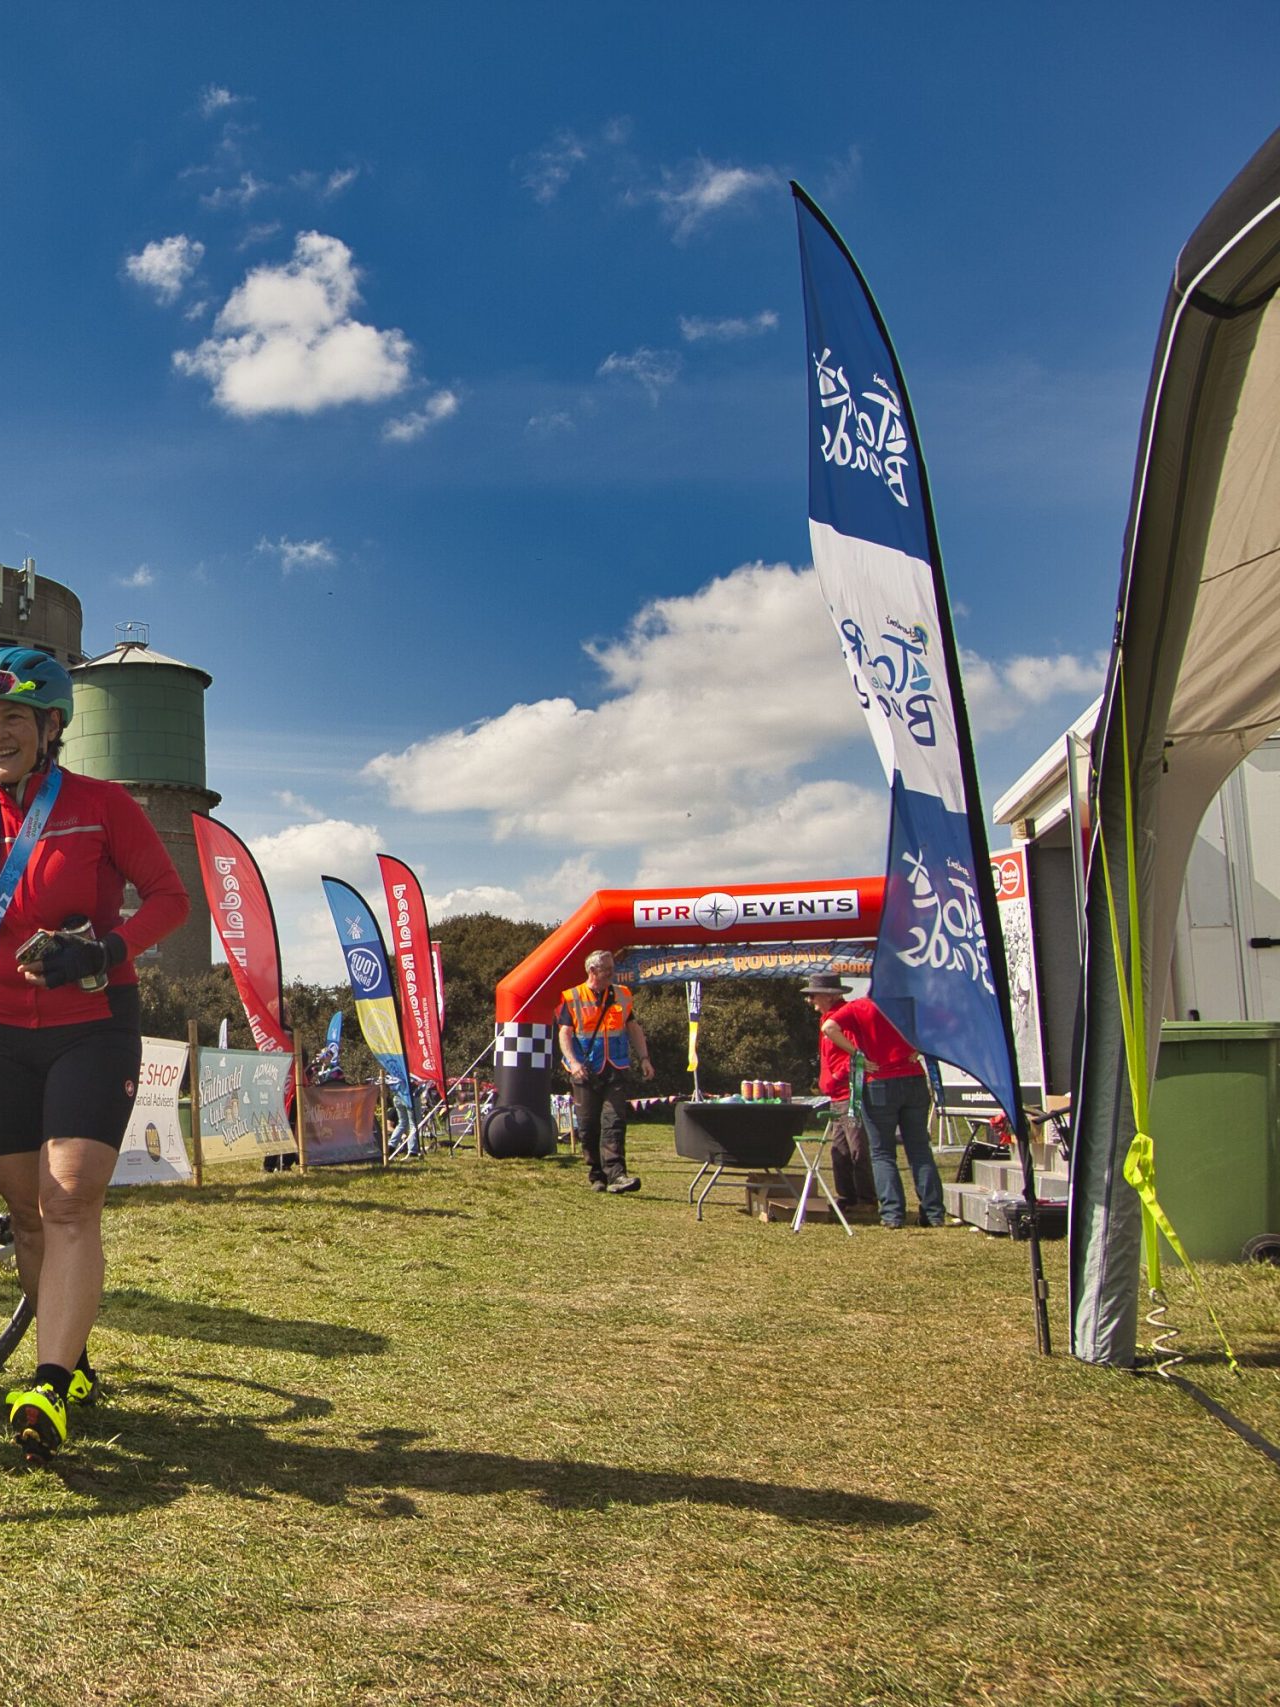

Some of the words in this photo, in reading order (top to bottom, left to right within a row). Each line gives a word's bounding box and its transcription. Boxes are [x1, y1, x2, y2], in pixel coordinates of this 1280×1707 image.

[640, 906, 690, 921] TPR
[742, 897, 854, 917] EVENTS
[638, 951, 727, 978] SUFFOLK
[731, 947, 833, 973] ROUBAIX
[832, 961, 872, 974] SPORT
[146, 1064, 179, 1086] SHOP
